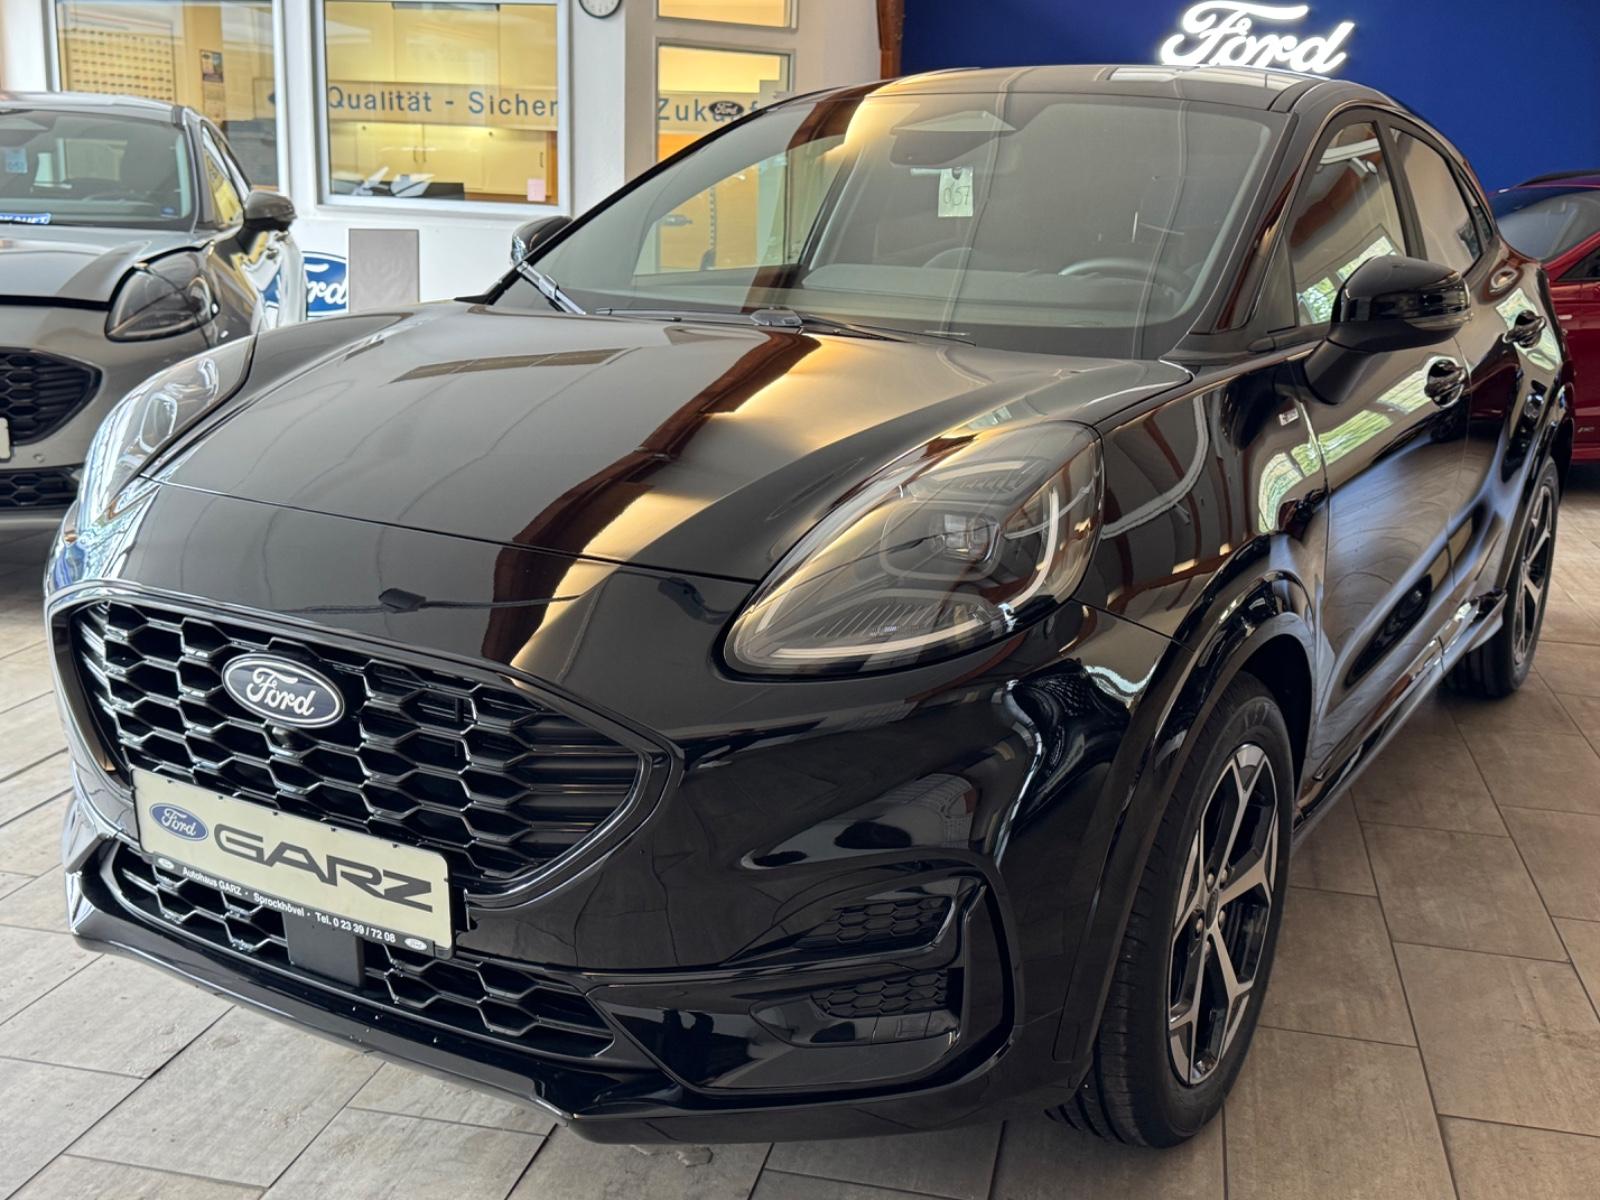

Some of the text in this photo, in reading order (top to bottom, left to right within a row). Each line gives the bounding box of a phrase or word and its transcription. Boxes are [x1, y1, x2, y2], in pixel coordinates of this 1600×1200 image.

[1160, 0, 1355, 73] Ford
[327, 86, 432, 112] Qualität
[246, 667, 316, 716] Ford
[161, 808, 197, 836] Ford
[214, 823, 433, 913] GARZ
[183, 867, 217, 887] Autohaus
[219, 880, 242, 896] GARZ
[253, 892, 304, 917] Sprockhövel
[315, 912, 331, 925] Tel.
[333, 918, 339, 927] 0
[340, 920, 352, 931] 23
[353, 923, 364, 934] 39
[371, 928, 382, 940] 72
[384, 932, 396, 943] 08
